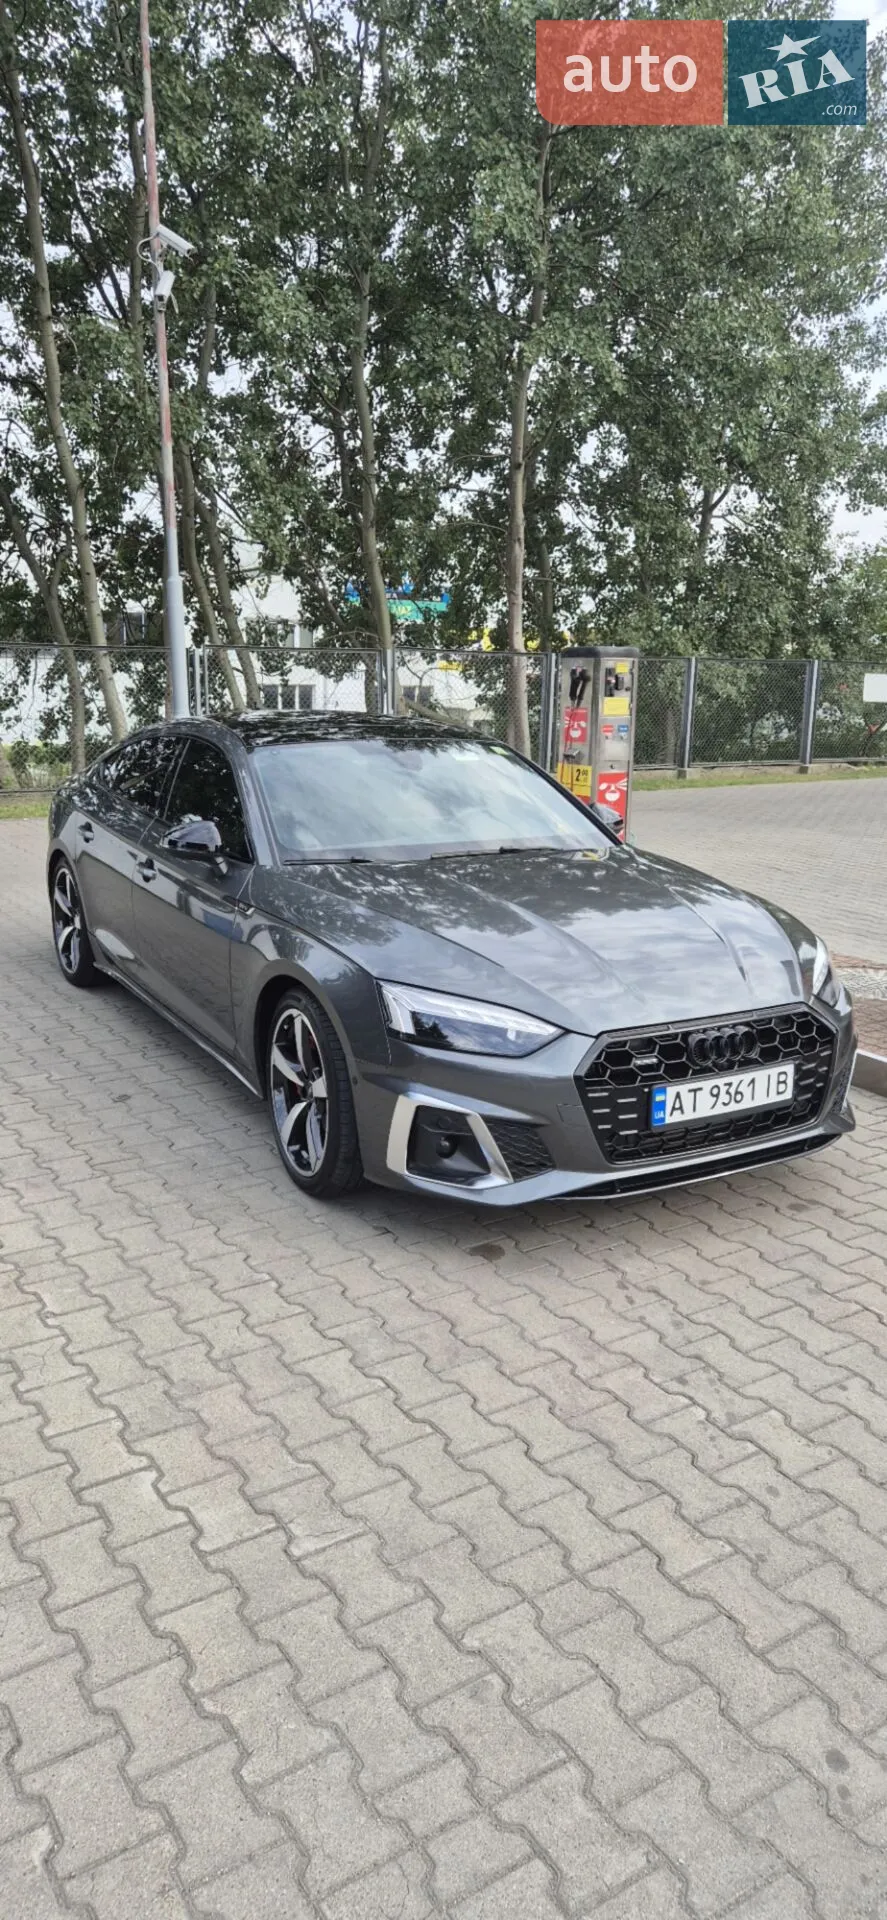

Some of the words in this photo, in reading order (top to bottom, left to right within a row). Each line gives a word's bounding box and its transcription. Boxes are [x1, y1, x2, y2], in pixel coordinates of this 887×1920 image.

[669, 1087, 703, 1117] AT
[709, 1077, 756, 1110] 9361
[766, 1071, 788, 1098] IB
[654, 1111, 665, 1119] UA
